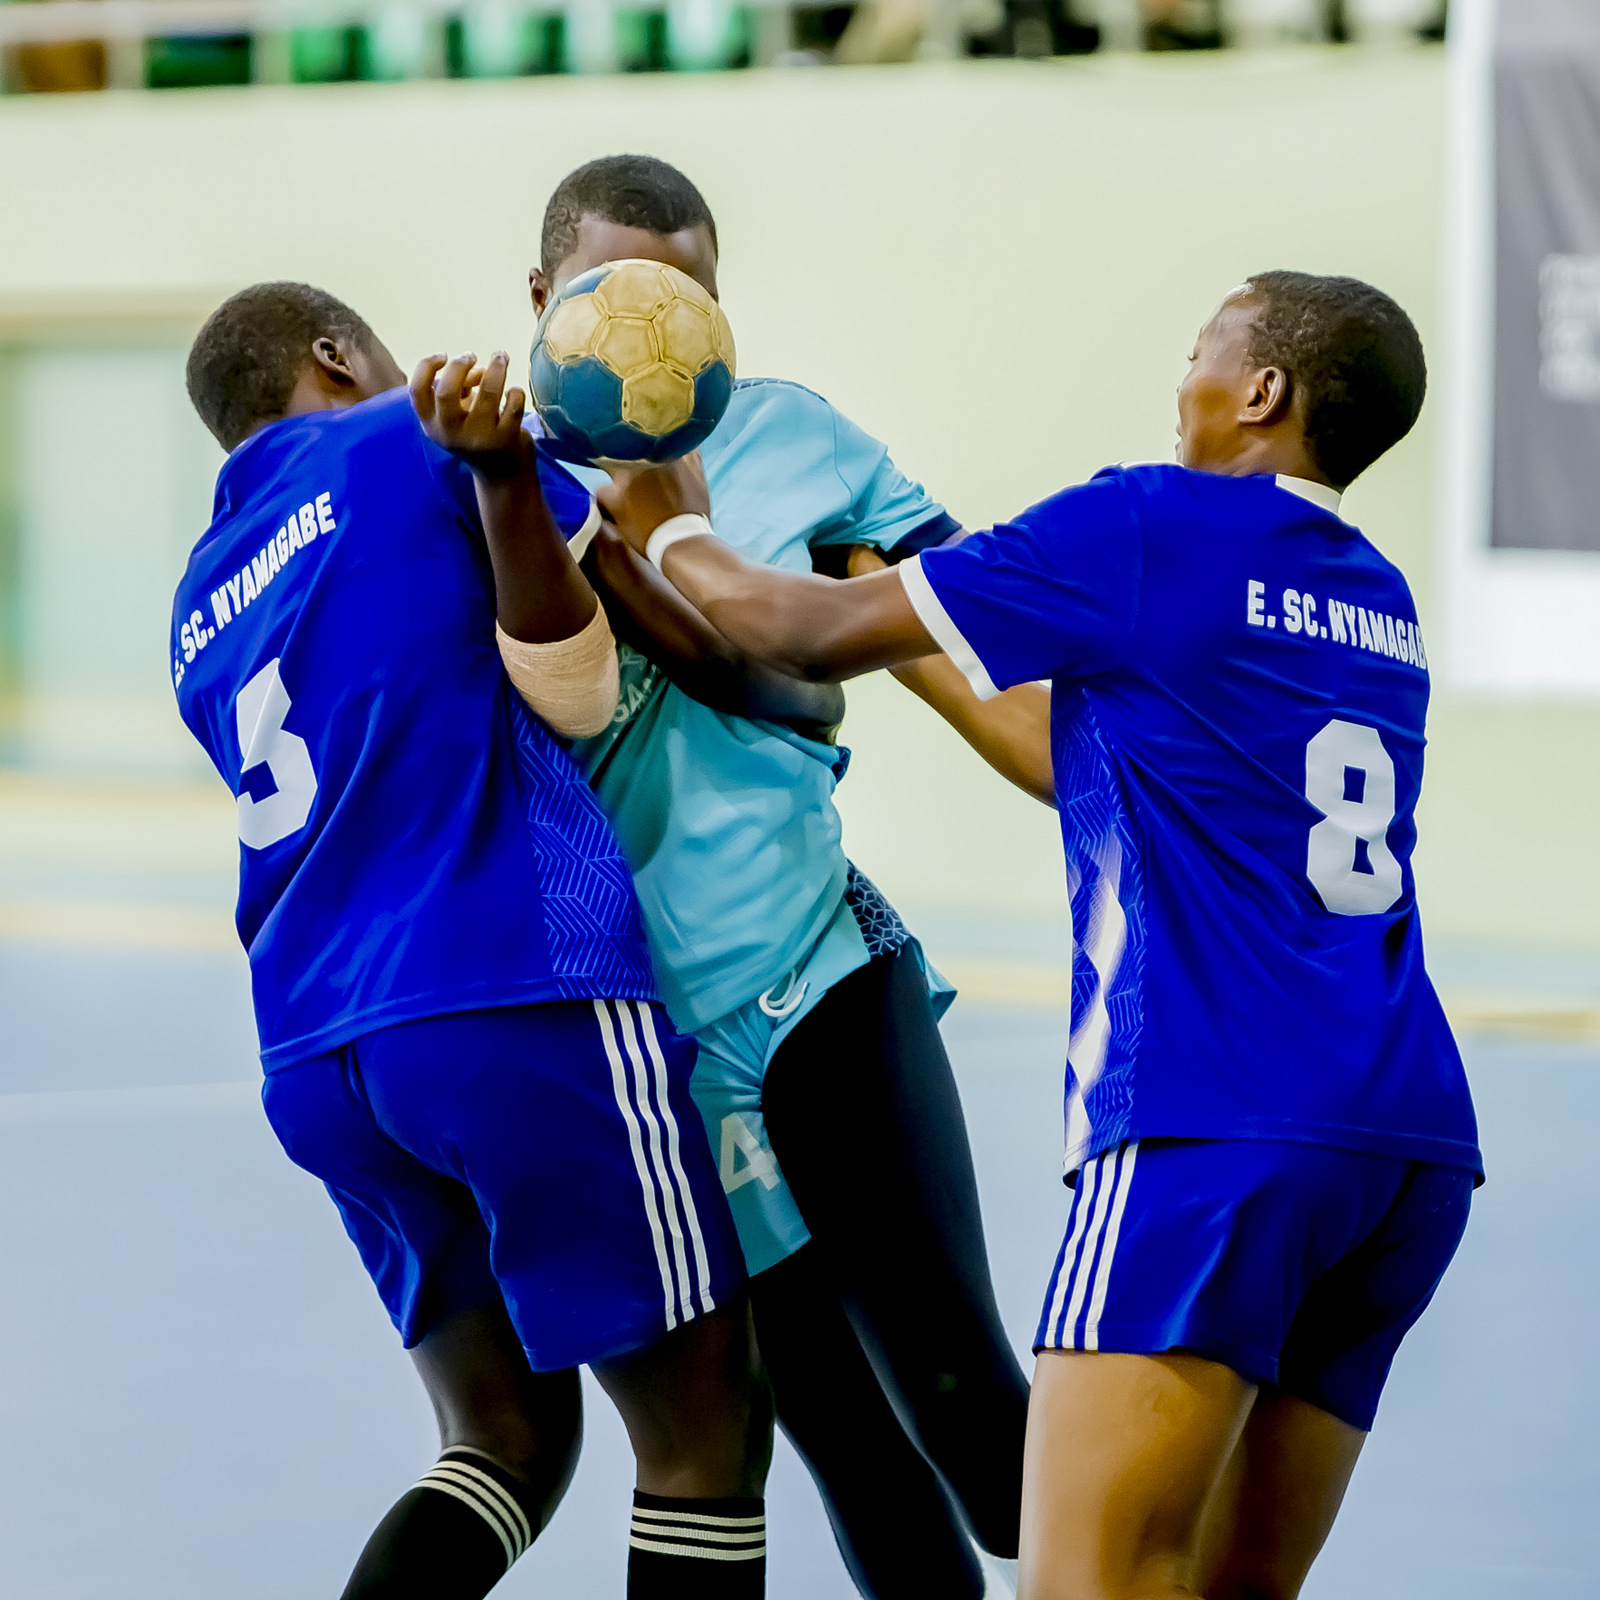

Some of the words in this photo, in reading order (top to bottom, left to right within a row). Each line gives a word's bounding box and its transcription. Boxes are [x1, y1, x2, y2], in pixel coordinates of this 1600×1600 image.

[1247, 579, 1276, 628] E.
[236, 657, 318, 850] 3
[1305, 719, 1403, 916] 8
[719, 1111, 781, 1195] 4
